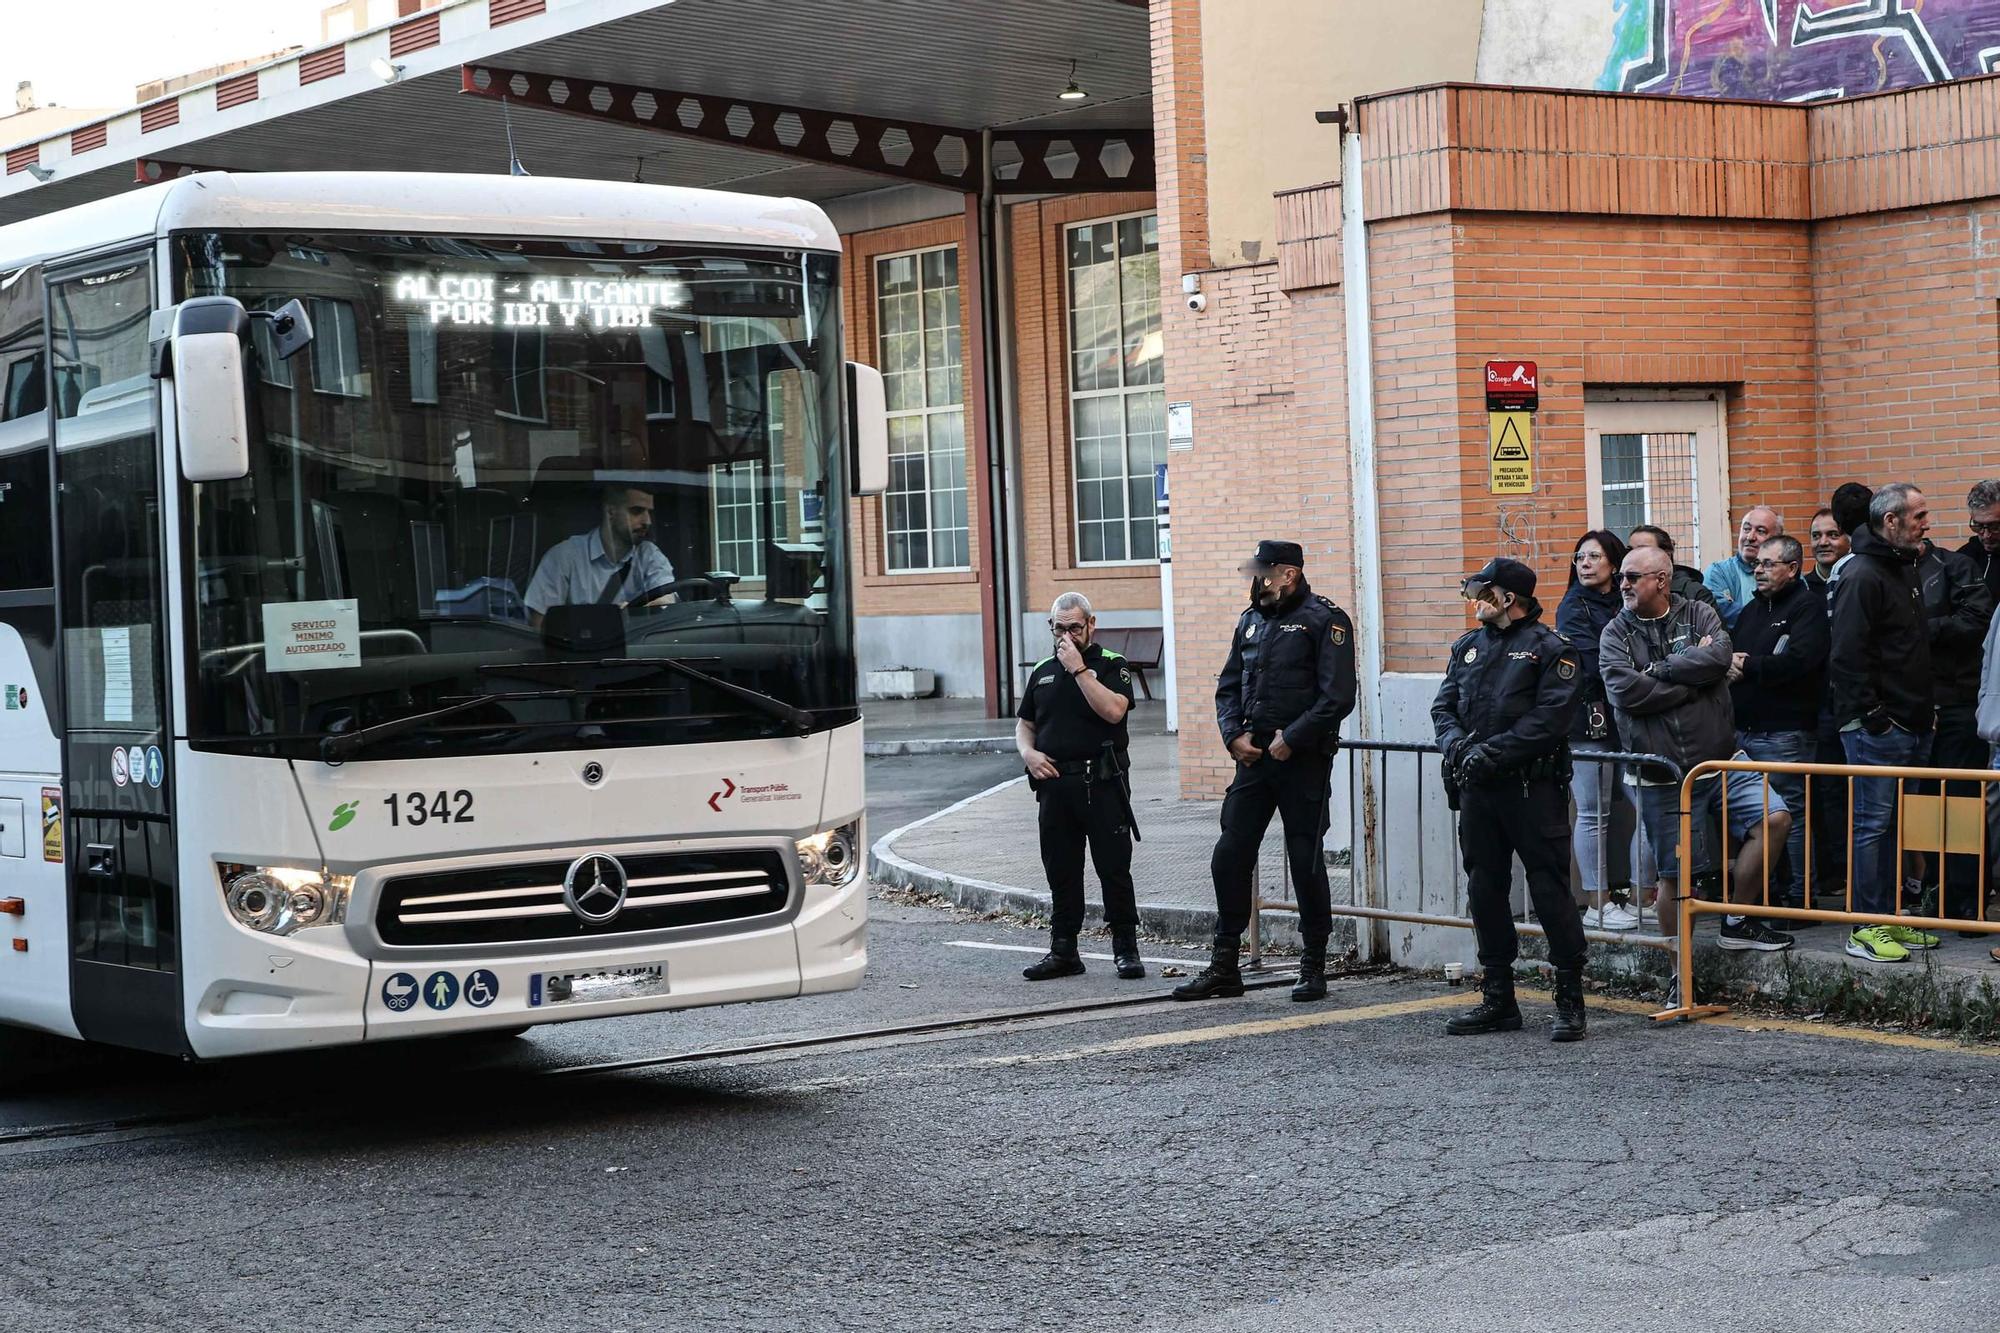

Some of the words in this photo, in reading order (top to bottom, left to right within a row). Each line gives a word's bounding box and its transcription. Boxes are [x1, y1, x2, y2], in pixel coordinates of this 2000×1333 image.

[396, 276, 495, 301] ALCOI
[530, 280, 681, 306] ALICANTE
[430, 301, 493, 324] POR
[504, 302, 550, 325] IBI
[590, 303, 652, 328] TIBI
[291, 620, 336, 631] SERVICIO
[285, 642, 346, 654] AUTORIZADO
[740, 785, 769, 794] Transport
[383, 789, 475, 827] 1342
